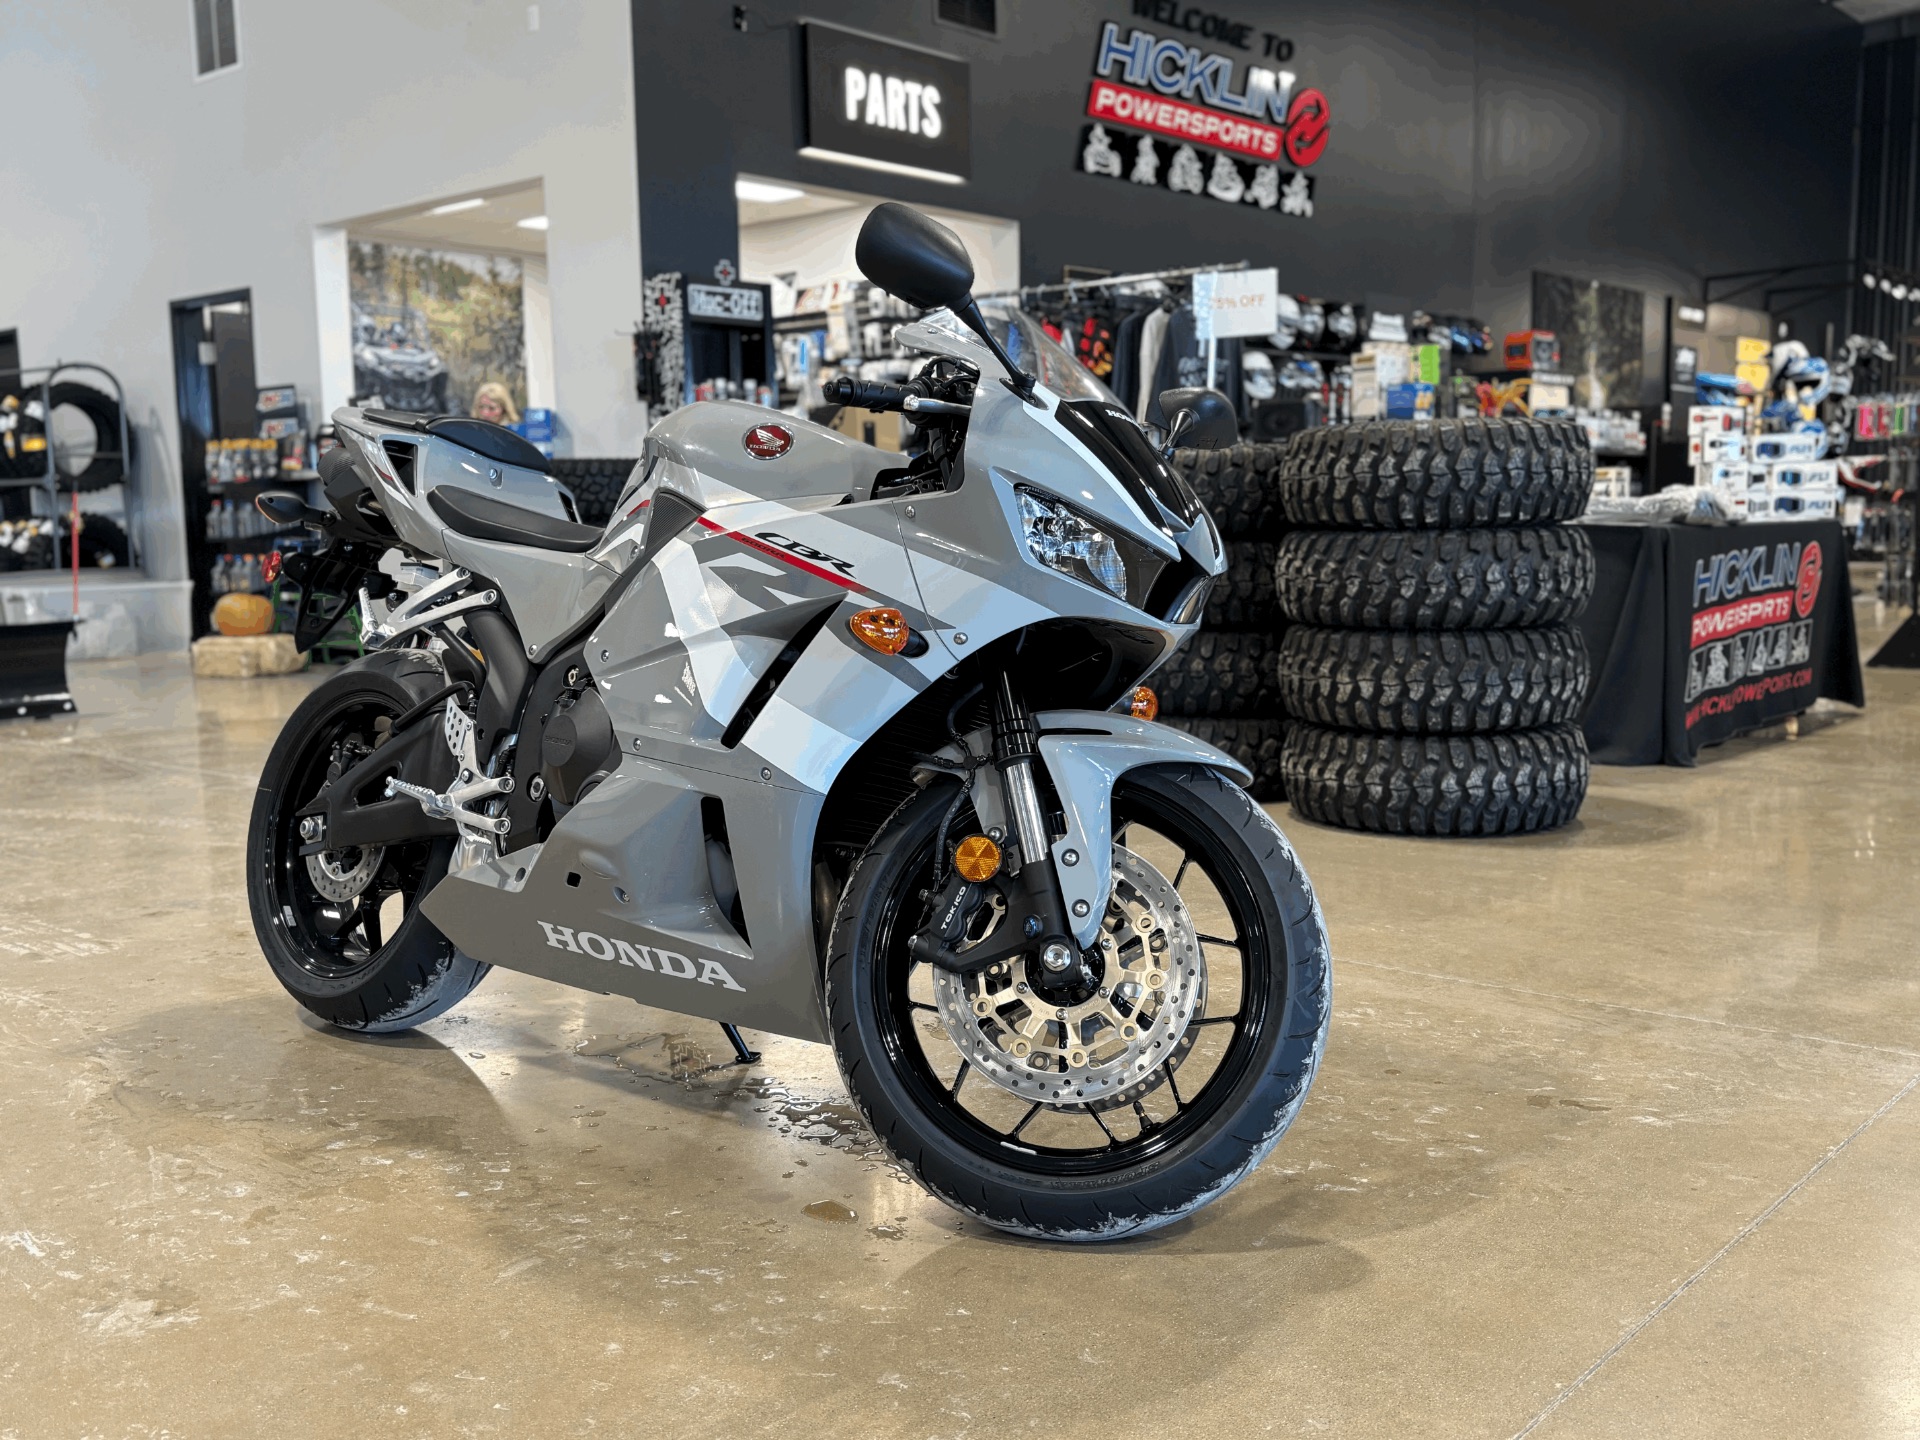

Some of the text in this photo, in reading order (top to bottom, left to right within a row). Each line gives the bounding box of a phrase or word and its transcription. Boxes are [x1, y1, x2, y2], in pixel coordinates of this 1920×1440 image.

[1132, 0, 1295, 62] WELCOME TO
[845, 66, 942, 139] PARTS
[1097, 22, 1296, 124] HICKLIN
[1096, 86, 1280, 154] POWERSPORTS
[749, 444, 782, 453] HONDA
[754, 532, 858, 580] CBR
[1693, 541, 1801, 608] HICKLIN
[940, 886, 967, 930] TOKICO
[537, 920, 747, 993] HONDA
